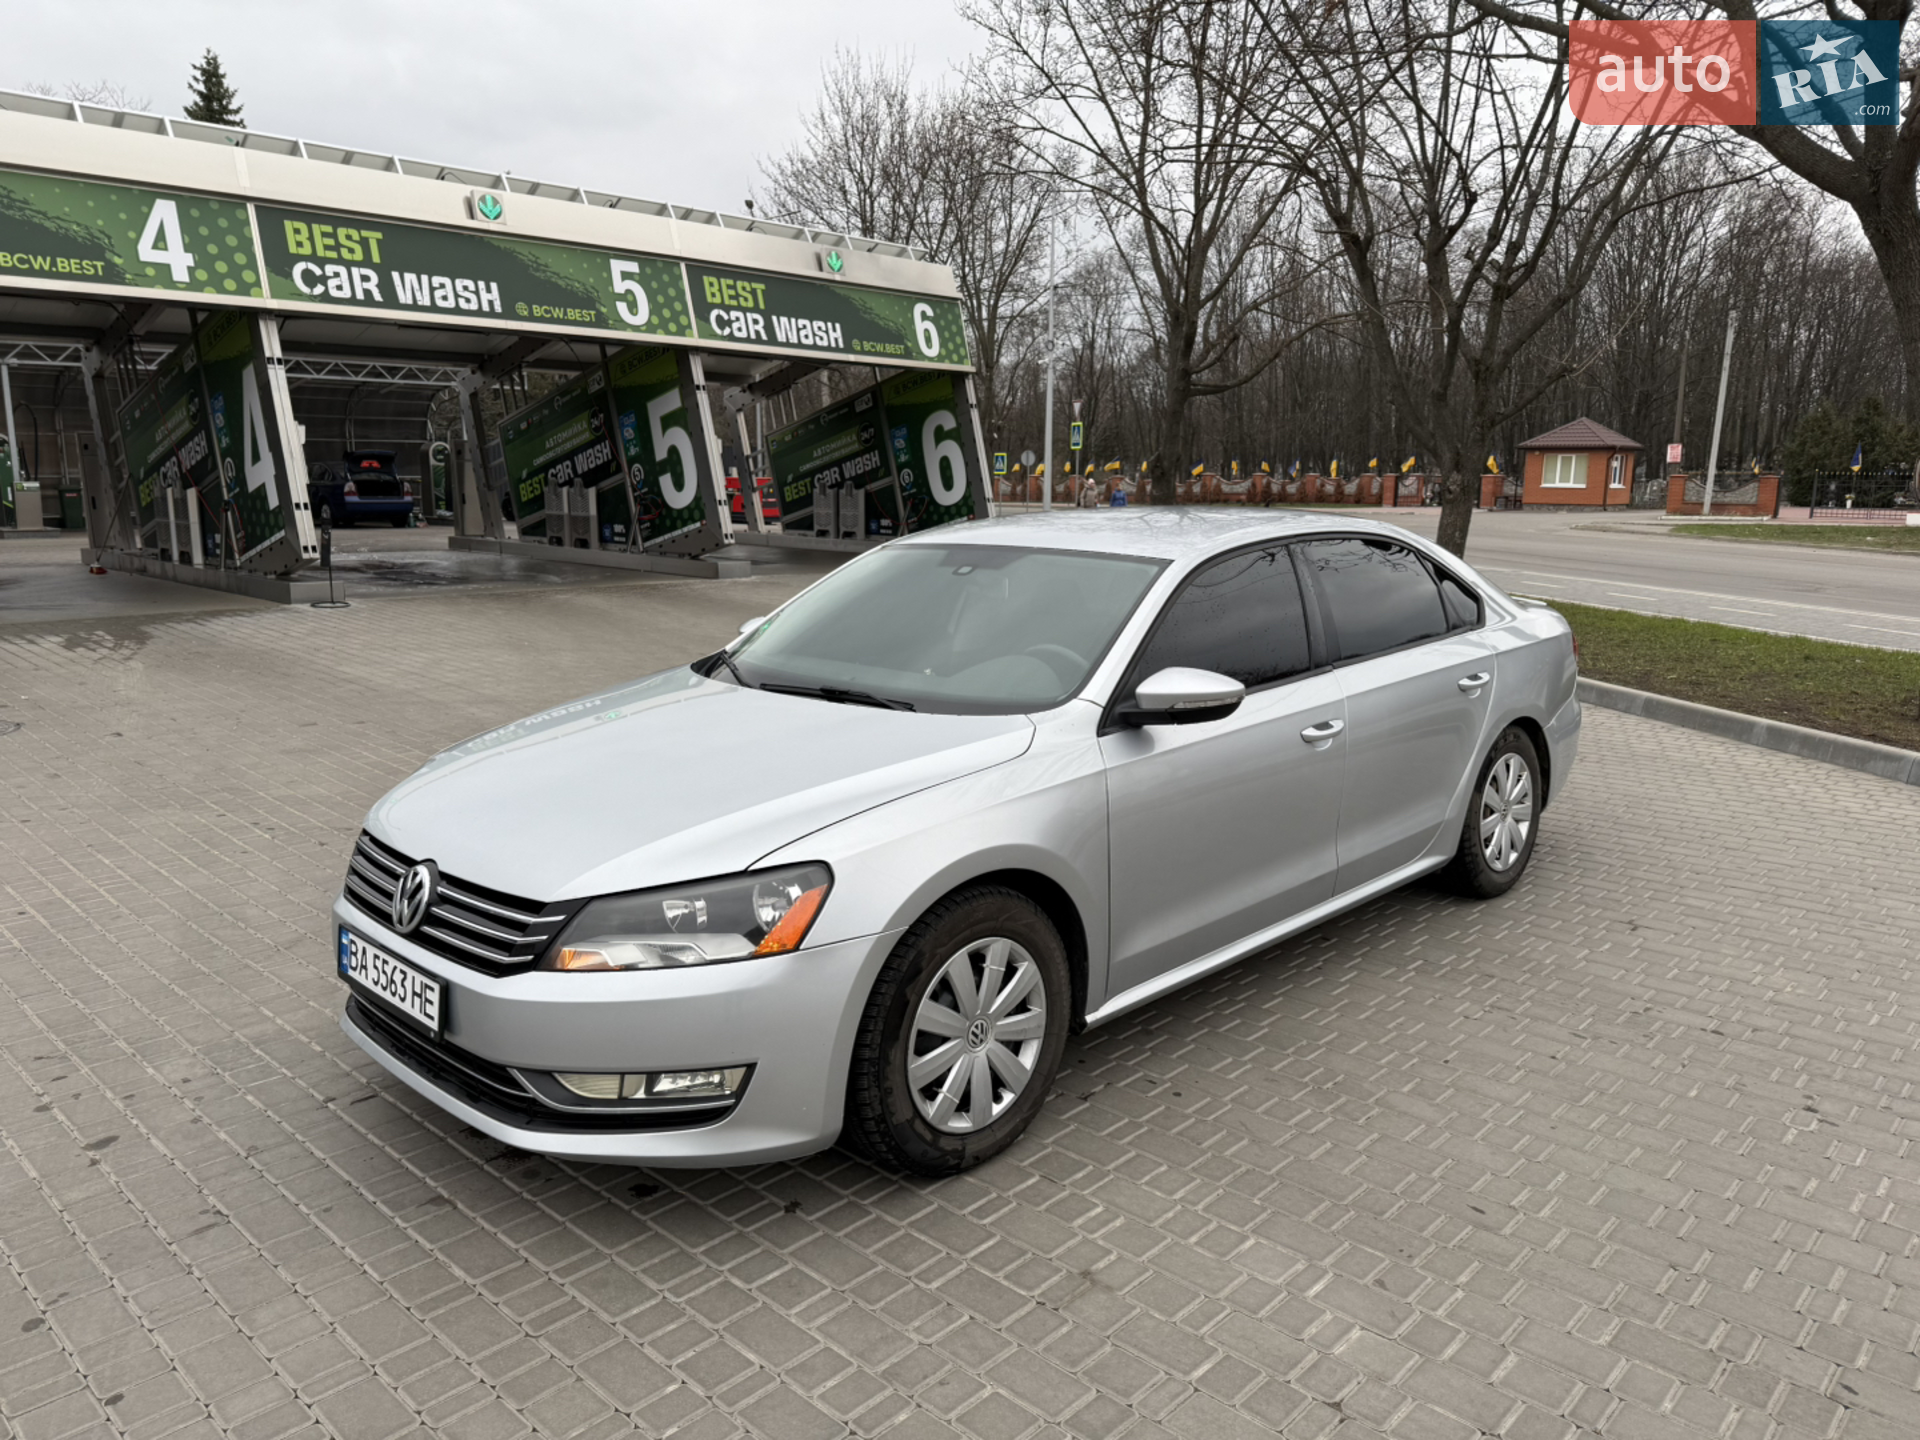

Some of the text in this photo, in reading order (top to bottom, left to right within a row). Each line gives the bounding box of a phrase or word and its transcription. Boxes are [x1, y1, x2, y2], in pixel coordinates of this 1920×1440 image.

[137, 198, 195, 283] 4
[284, 219, 383, 264] BEST
[0, 252, 105, 276] BCW.BEST
[610, 258, 650, 327] 5
[703, 275, 766, 310] BEST
[532, 303, 597, 323] BCW.BEST
[913, 302, 941, 358] 6
[862, 339, 905, 356] BCW.BEST
[241, 361, 279, 511] 4
[545, 419, 588, 450] АВТОМИЙКА
[646, 387, 698, 510] 5
[633, 469, 641, 481] 5
[921, 409, 967, 506] 6
[519, 473, 545, 502] BEST
[783, 477, 812, 502] BEST
[349, 938, 435, 1022] BA 5563 HE
